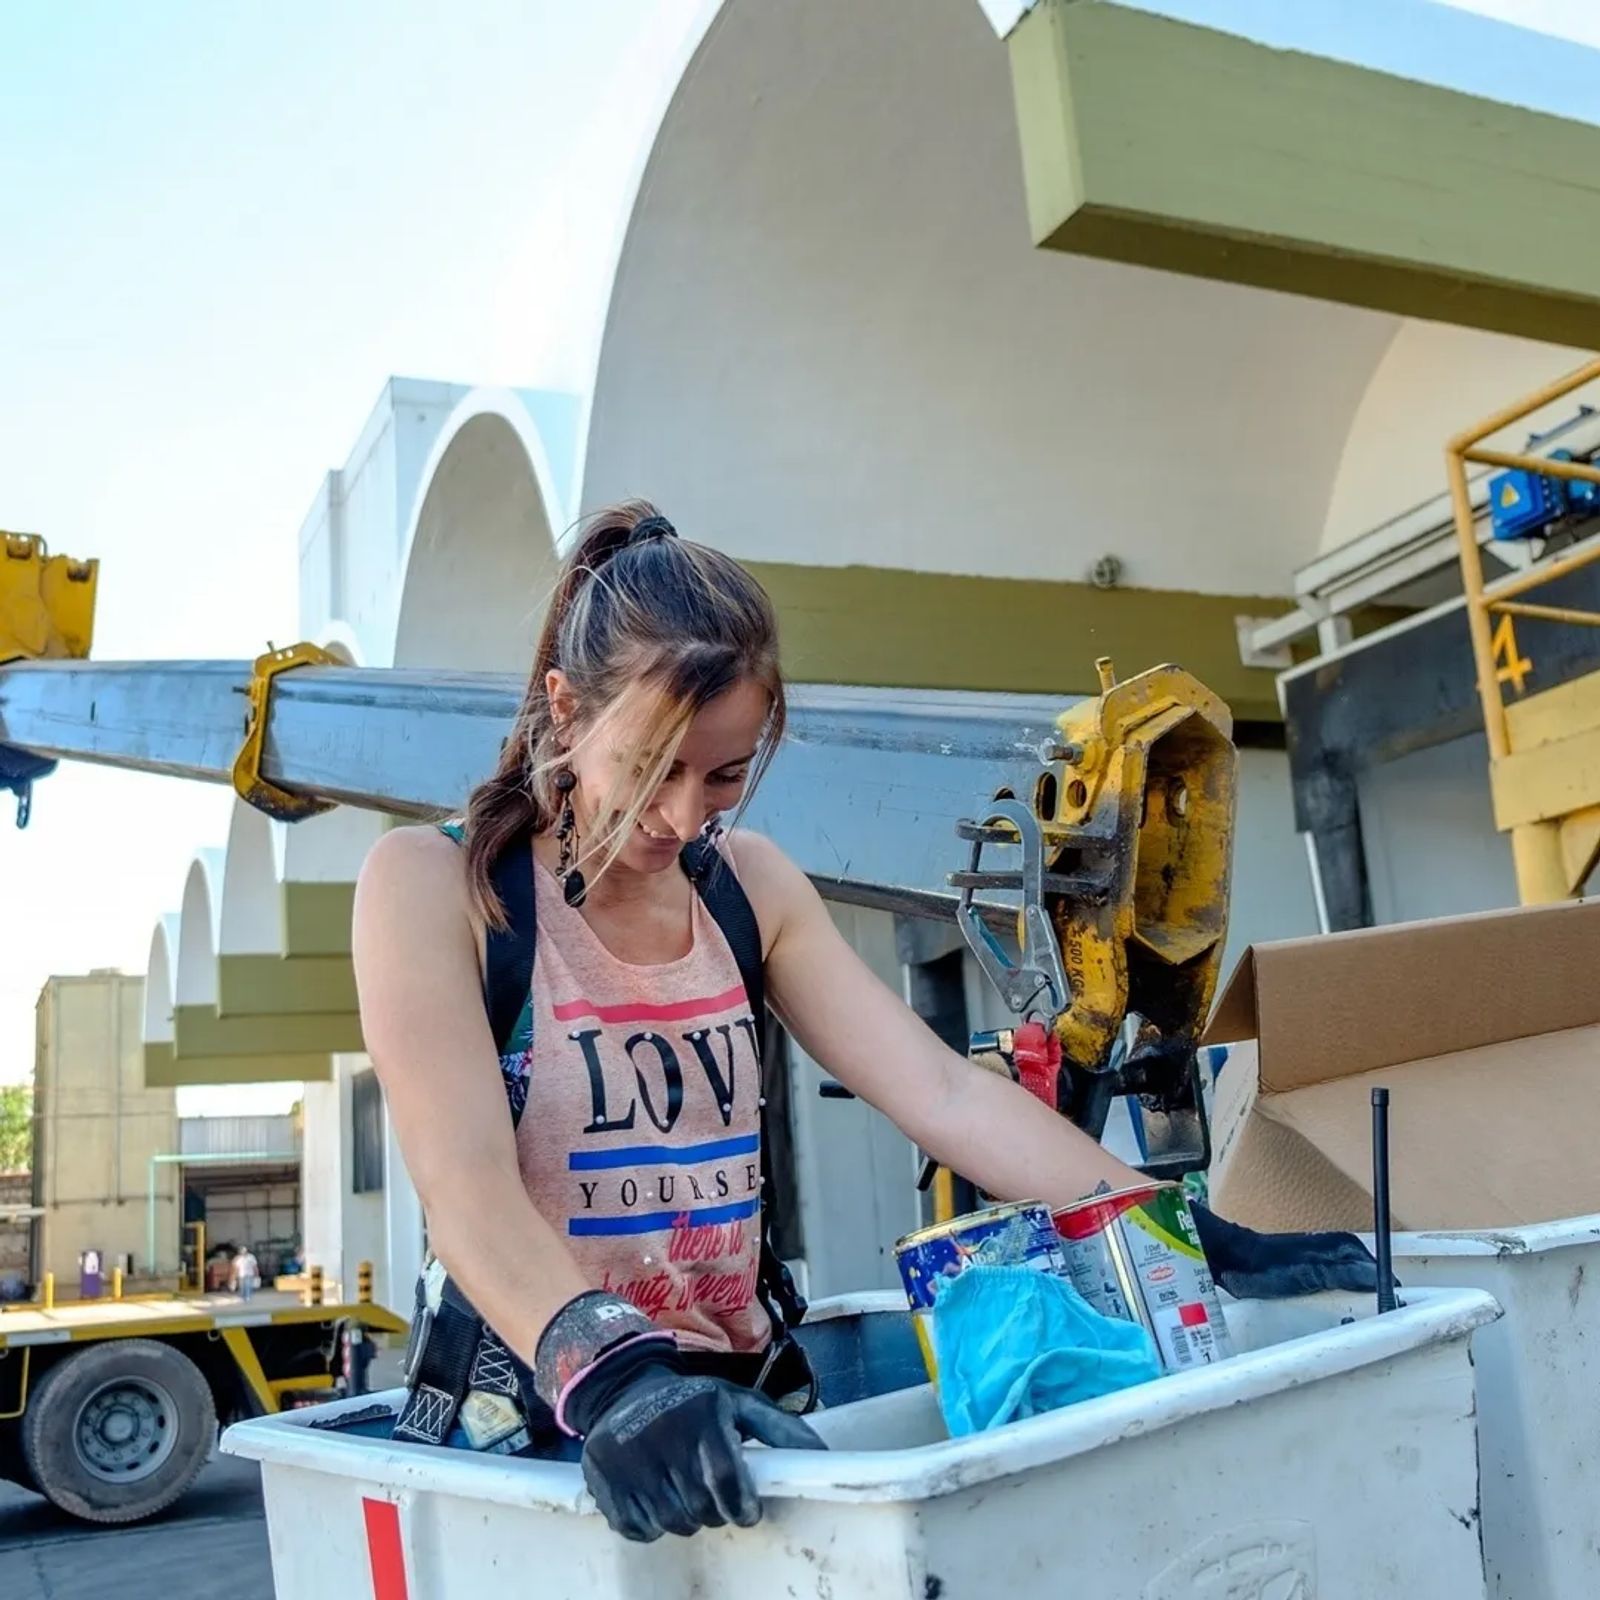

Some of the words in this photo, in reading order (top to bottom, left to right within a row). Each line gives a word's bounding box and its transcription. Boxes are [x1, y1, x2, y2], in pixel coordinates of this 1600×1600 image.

[1490, 613, 1534, 694] 4
[568, 1016, 763, 1133] LOV
[667, 1211, 726, 1263] there
